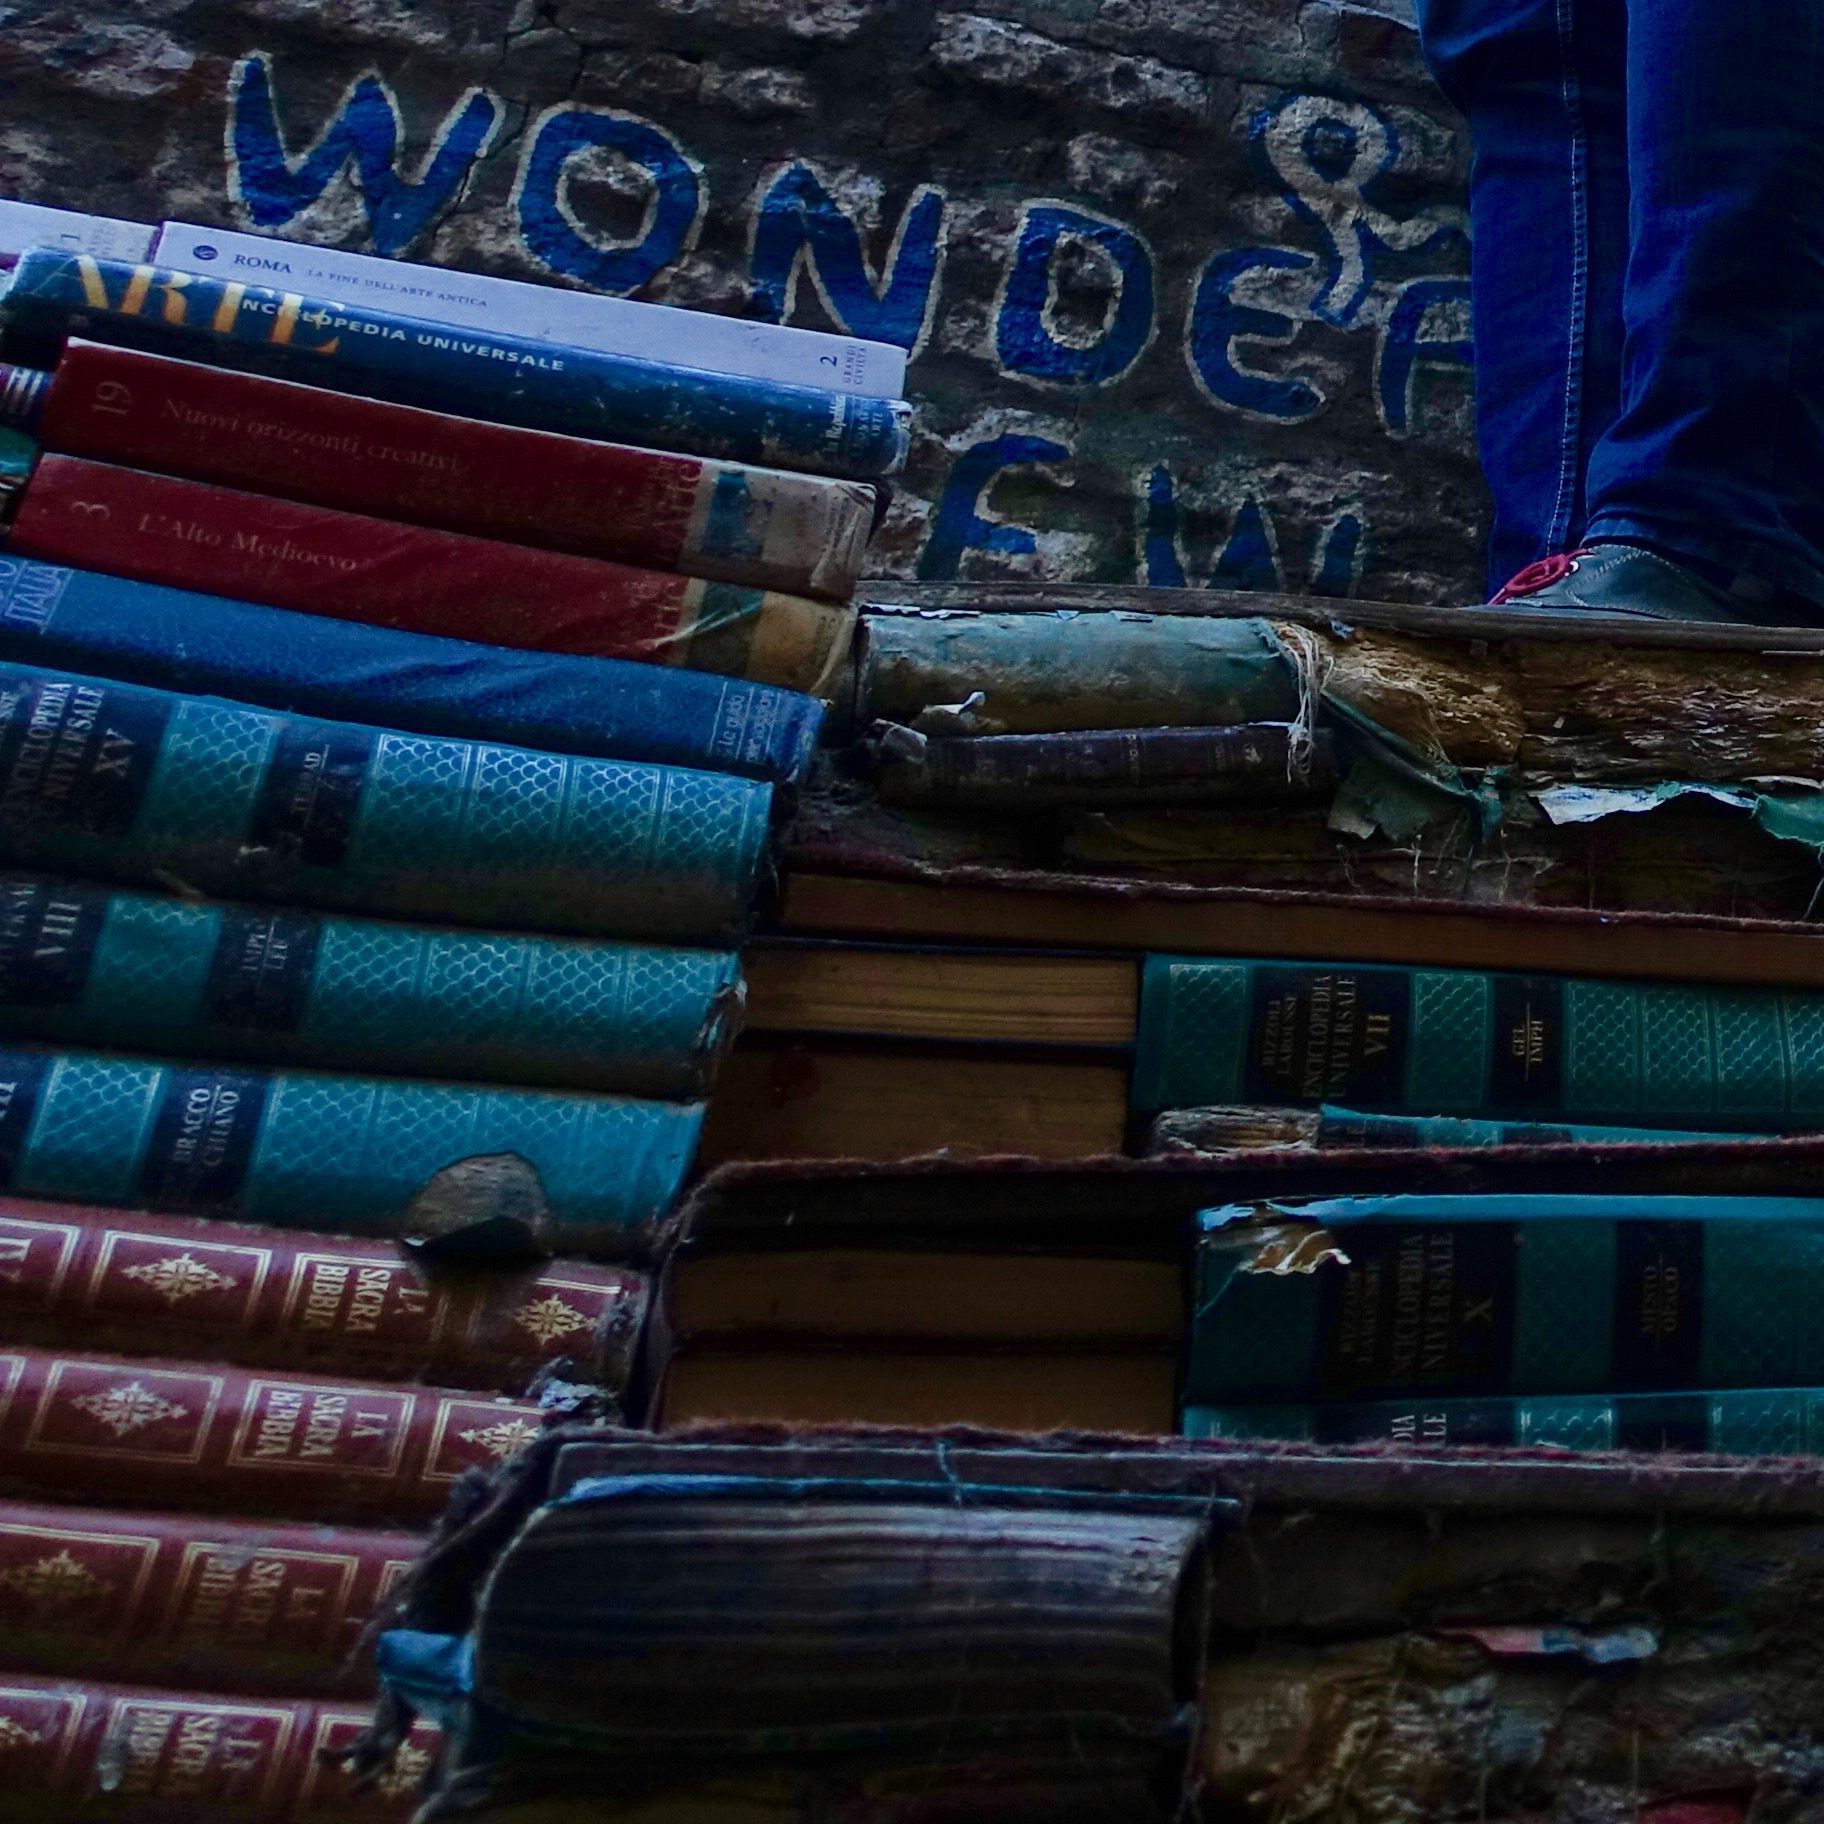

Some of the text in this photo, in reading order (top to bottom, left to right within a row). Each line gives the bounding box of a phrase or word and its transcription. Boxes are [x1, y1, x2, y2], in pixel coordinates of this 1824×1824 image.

[60, 253, 346, 356] ARTE
[233, 253, 293, 276] ROMA
[329, 271, 360, 284] FINE
[437, 292, 488, 307] ANTICA
[228, 292, 566, 373] NCCLOPEDIA UNIVERSALE
[820, 354, 838, 367] 2
[843, 344, 858, 385] GRANDI
[91, 379, 132, 417] 19
[159, 397, 459, 472] Nuovi orizzonti creativi
[137, 513, 358, 573] L'Alto Medioevo
[40, 684, 104, 804] NIVERSALE
[93, 727, 135, 778] XV
[33, 902, 81, 958] VIII
[1262, 999, 1282, 1066] RIZZOLI
[1276, 994, 1298, 1076] LAROUSSE
[1301, 975, 1333, 1099] ENCICLOPEDIA
[1327, 975, 1357, 1100] UNIVERSALE
[1364, 1013, 1392, 1057] VII
[1511, 1025, 1525, 1057] GEL
[1529, 1019, 1544, 1063] IMPH
[171, 1087, 211, 1163] BRACCO
[303, 1262, 351, 1330] BIBBIA
[347, 1265, 393, 1333] SACRA
[394, 1285, 431, 1316] LA
[1391, 1232, 1426, 1371] NCICLOPEDIA
[1422, 1231, 1455, 1372] NIVERSALE
[1463, 1295, 1496, 1323] X
[254, 1387, 302, 1458] BIBBIA
[299, 1390, 349, 1457] SACRA
[351, 1408, 390, 1438] LA
[168, 1713, 222, 1786] SACR
